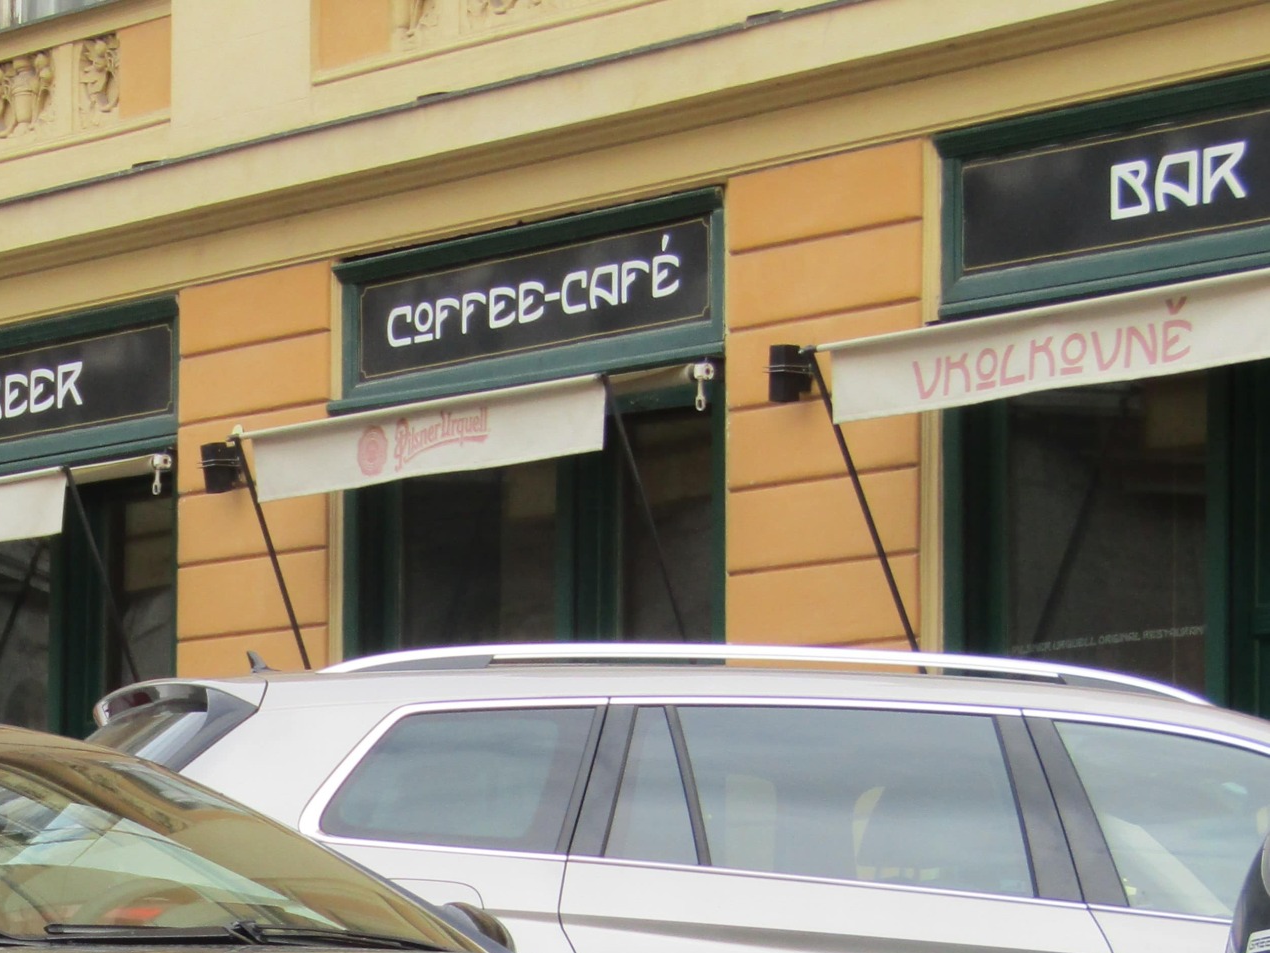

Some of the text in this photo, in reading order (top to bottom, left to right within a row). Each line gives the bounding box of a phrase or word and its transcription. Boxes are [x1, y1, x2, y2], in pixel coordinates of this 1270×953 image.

[1111, 141, 1247, 220] BAR
[387, 235, 680, 348] COFFEE-CAFÉ
[912, 296, 1194, 401] VKOLKOVNĚ
[394, 406, 489, 472] Pilsner Urquell
